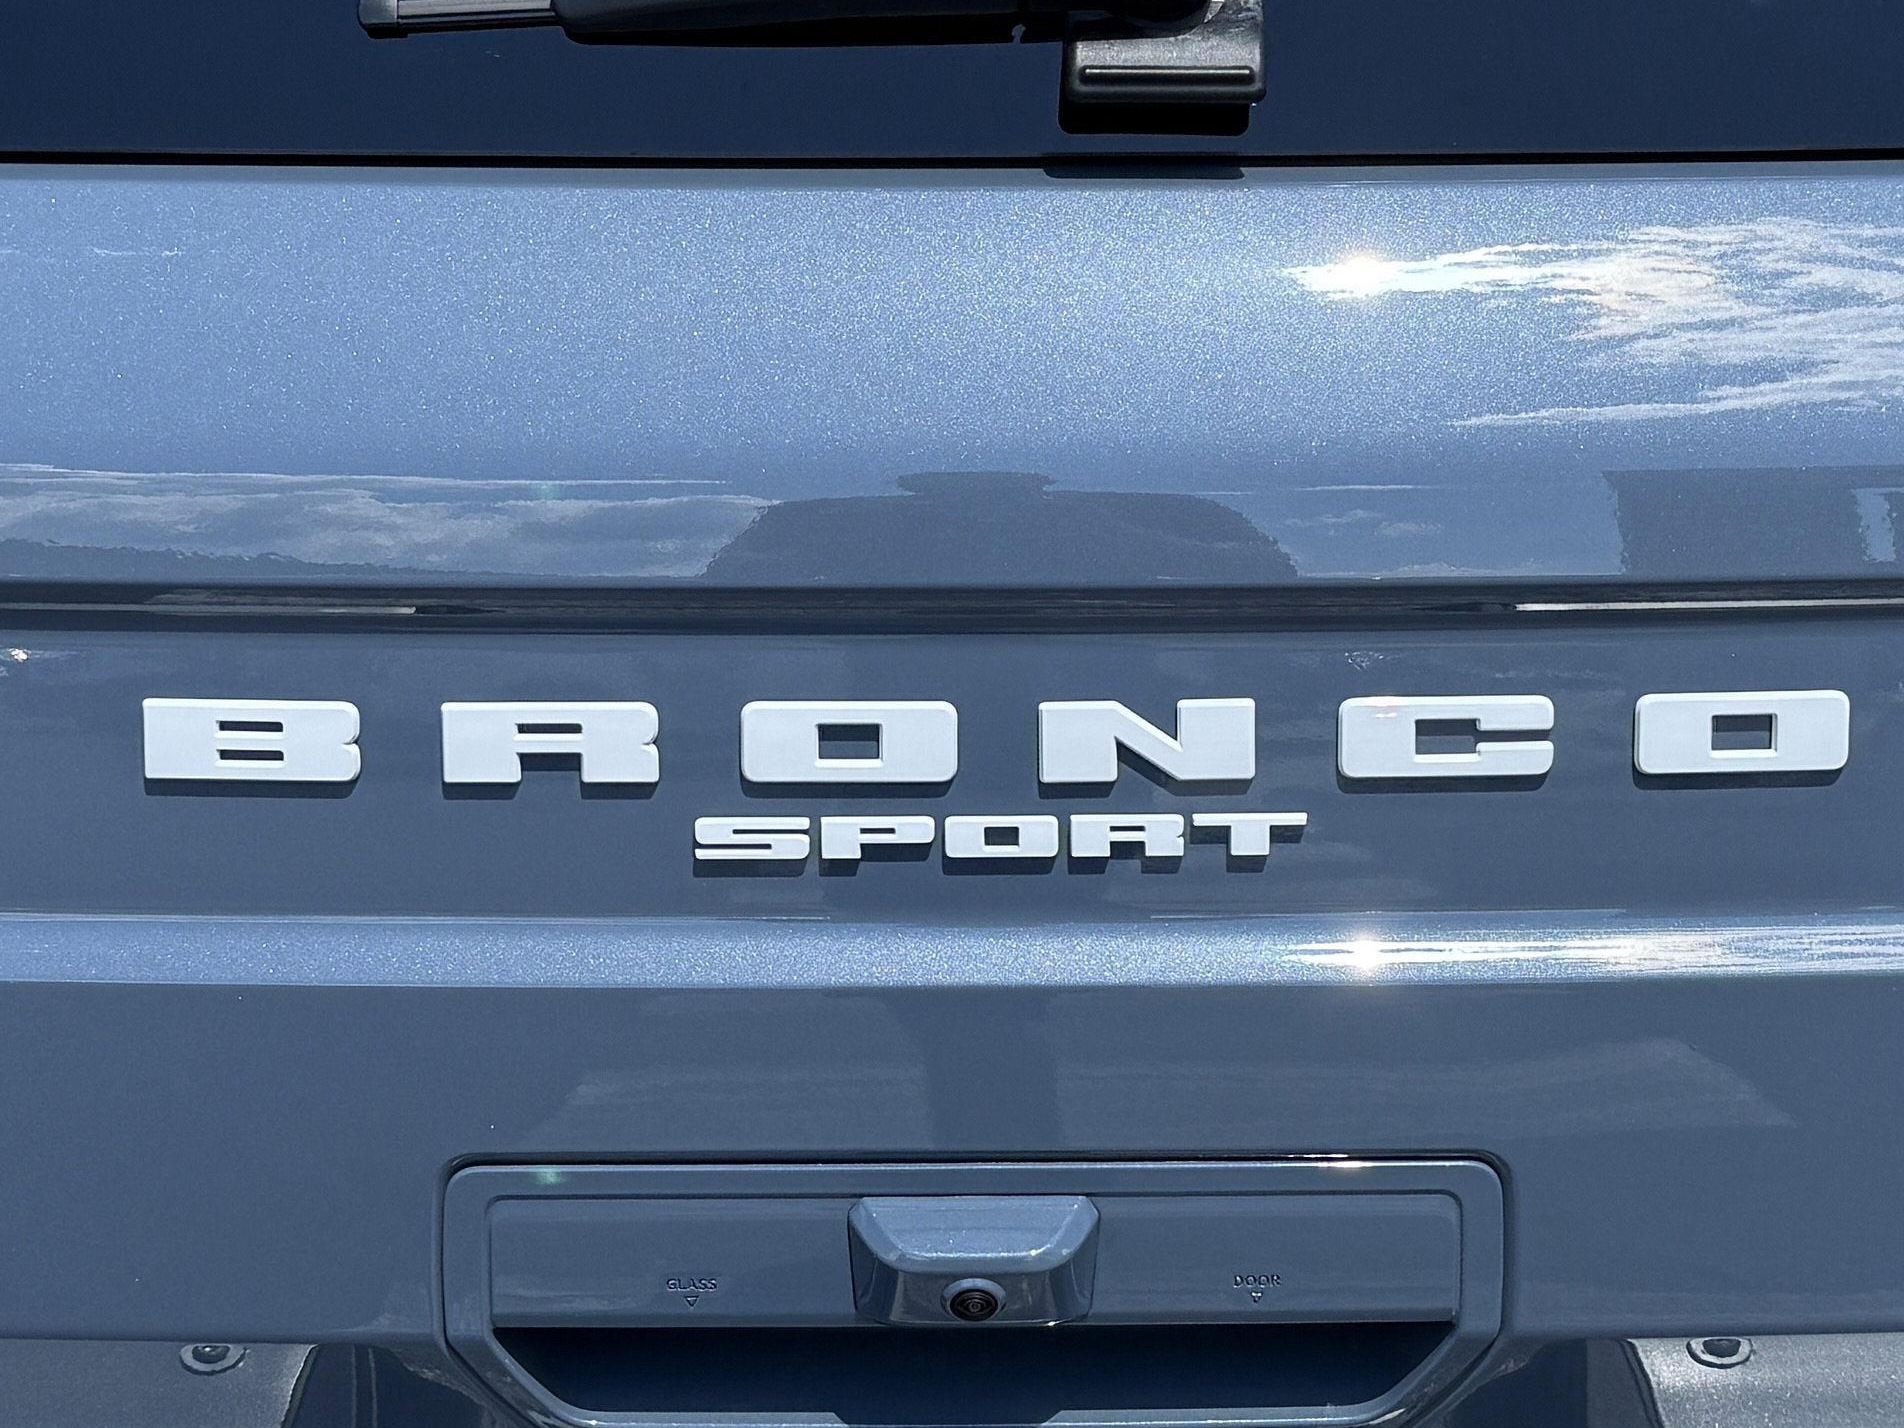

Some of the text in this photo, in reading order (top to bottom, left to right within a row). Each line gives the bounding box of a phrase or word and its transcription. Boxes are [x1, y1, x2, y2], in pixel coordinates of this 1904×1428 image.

[141, 688, 1851, 784] BRONCO
[693, 811, 1309, 861] SPORT
[666, 1277, 718, 1291] GLASS
[1233, 1274, 1282, 1288] DOOR
